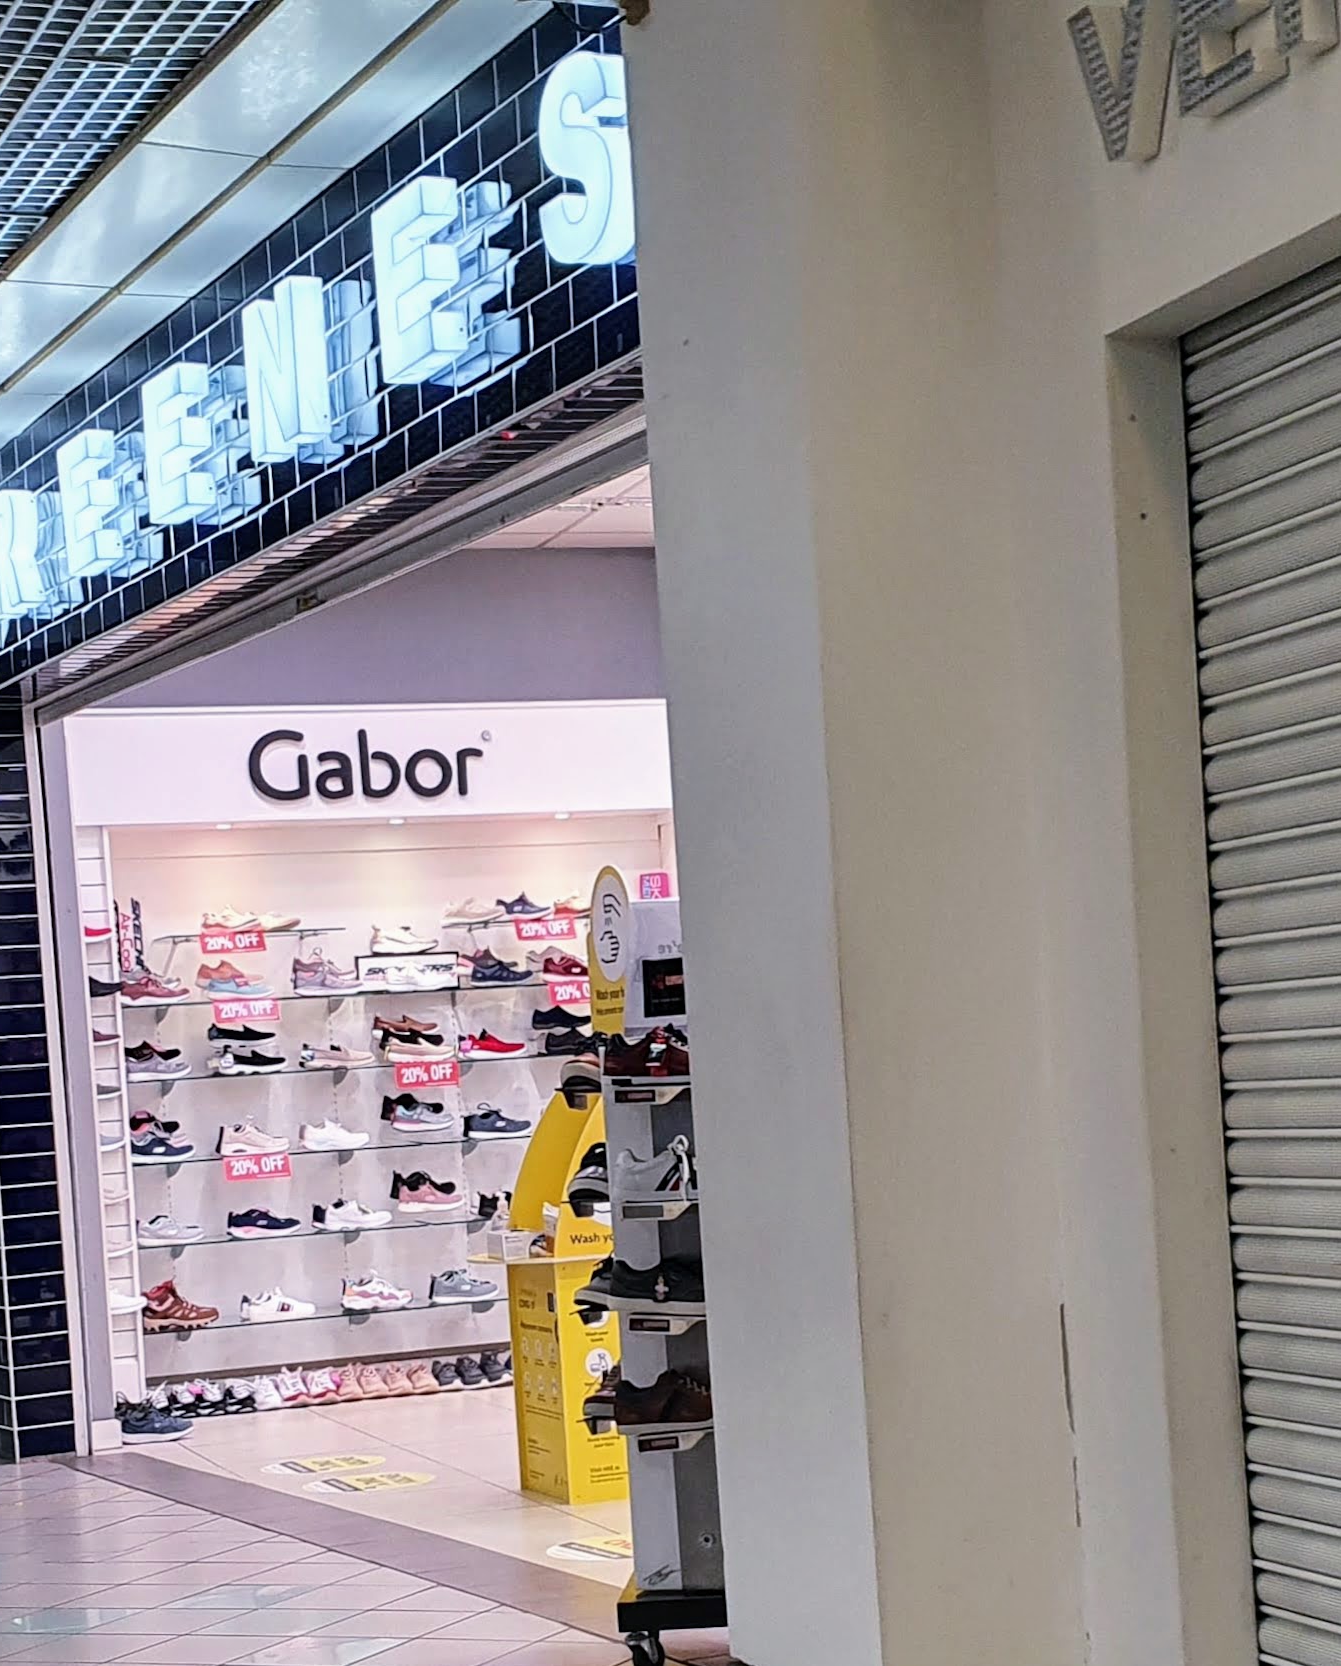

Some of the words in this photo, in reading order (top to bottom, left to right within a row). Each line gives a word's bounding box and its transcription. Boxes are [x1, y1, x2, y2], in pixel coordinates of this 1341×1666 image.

[248, 728, 484, 801] Gabor
[519, 923, 547, 937] 20%
[548, 920, 570, 935] OFF
[204, 935, 234, 951] 20%
[235, 932, 259, 949] OFF
[554, 984, 581, 1000] 20%
[219, 1001, 248, 1019] 20%
[249, 1000, 274, 1015] OFF
[401, 1066, 429, 1084] 20%
[430, 1063, 453, 1081] OFF
[230, 1159, 259, 1177] 20%
[260, 1155, 285, 1173] OFF
[570, 1232, 600, 1245] Wash
